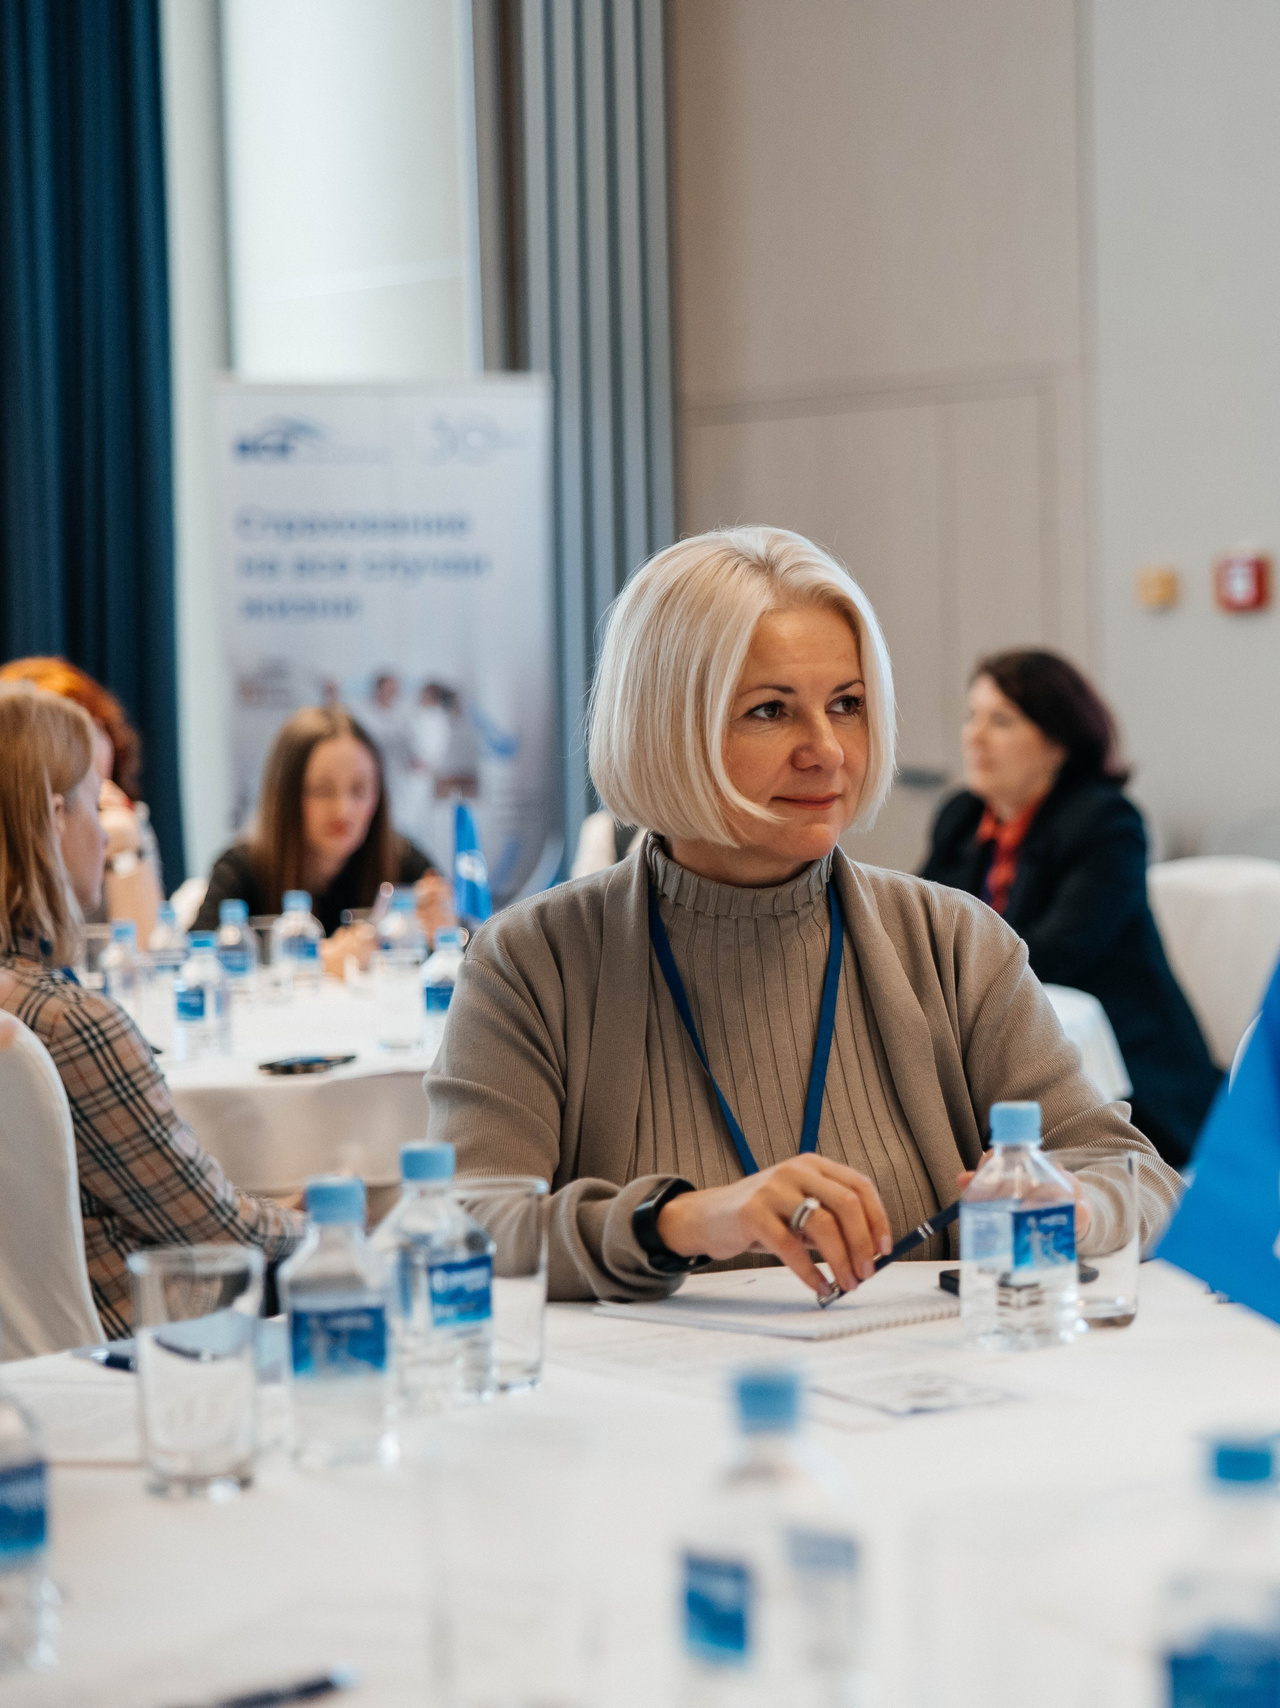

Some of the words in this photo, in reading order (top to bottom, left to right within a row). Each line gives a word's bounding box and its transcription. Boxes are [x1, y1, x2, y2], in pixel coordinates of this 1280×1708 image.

[235, 510, 474, 540] Страхование
[238, 553, 283, 580] на
[290, 553, 354, 580] все
[360, 553, 490, 584] случаи
[237, 596, 360, 620] жизни
